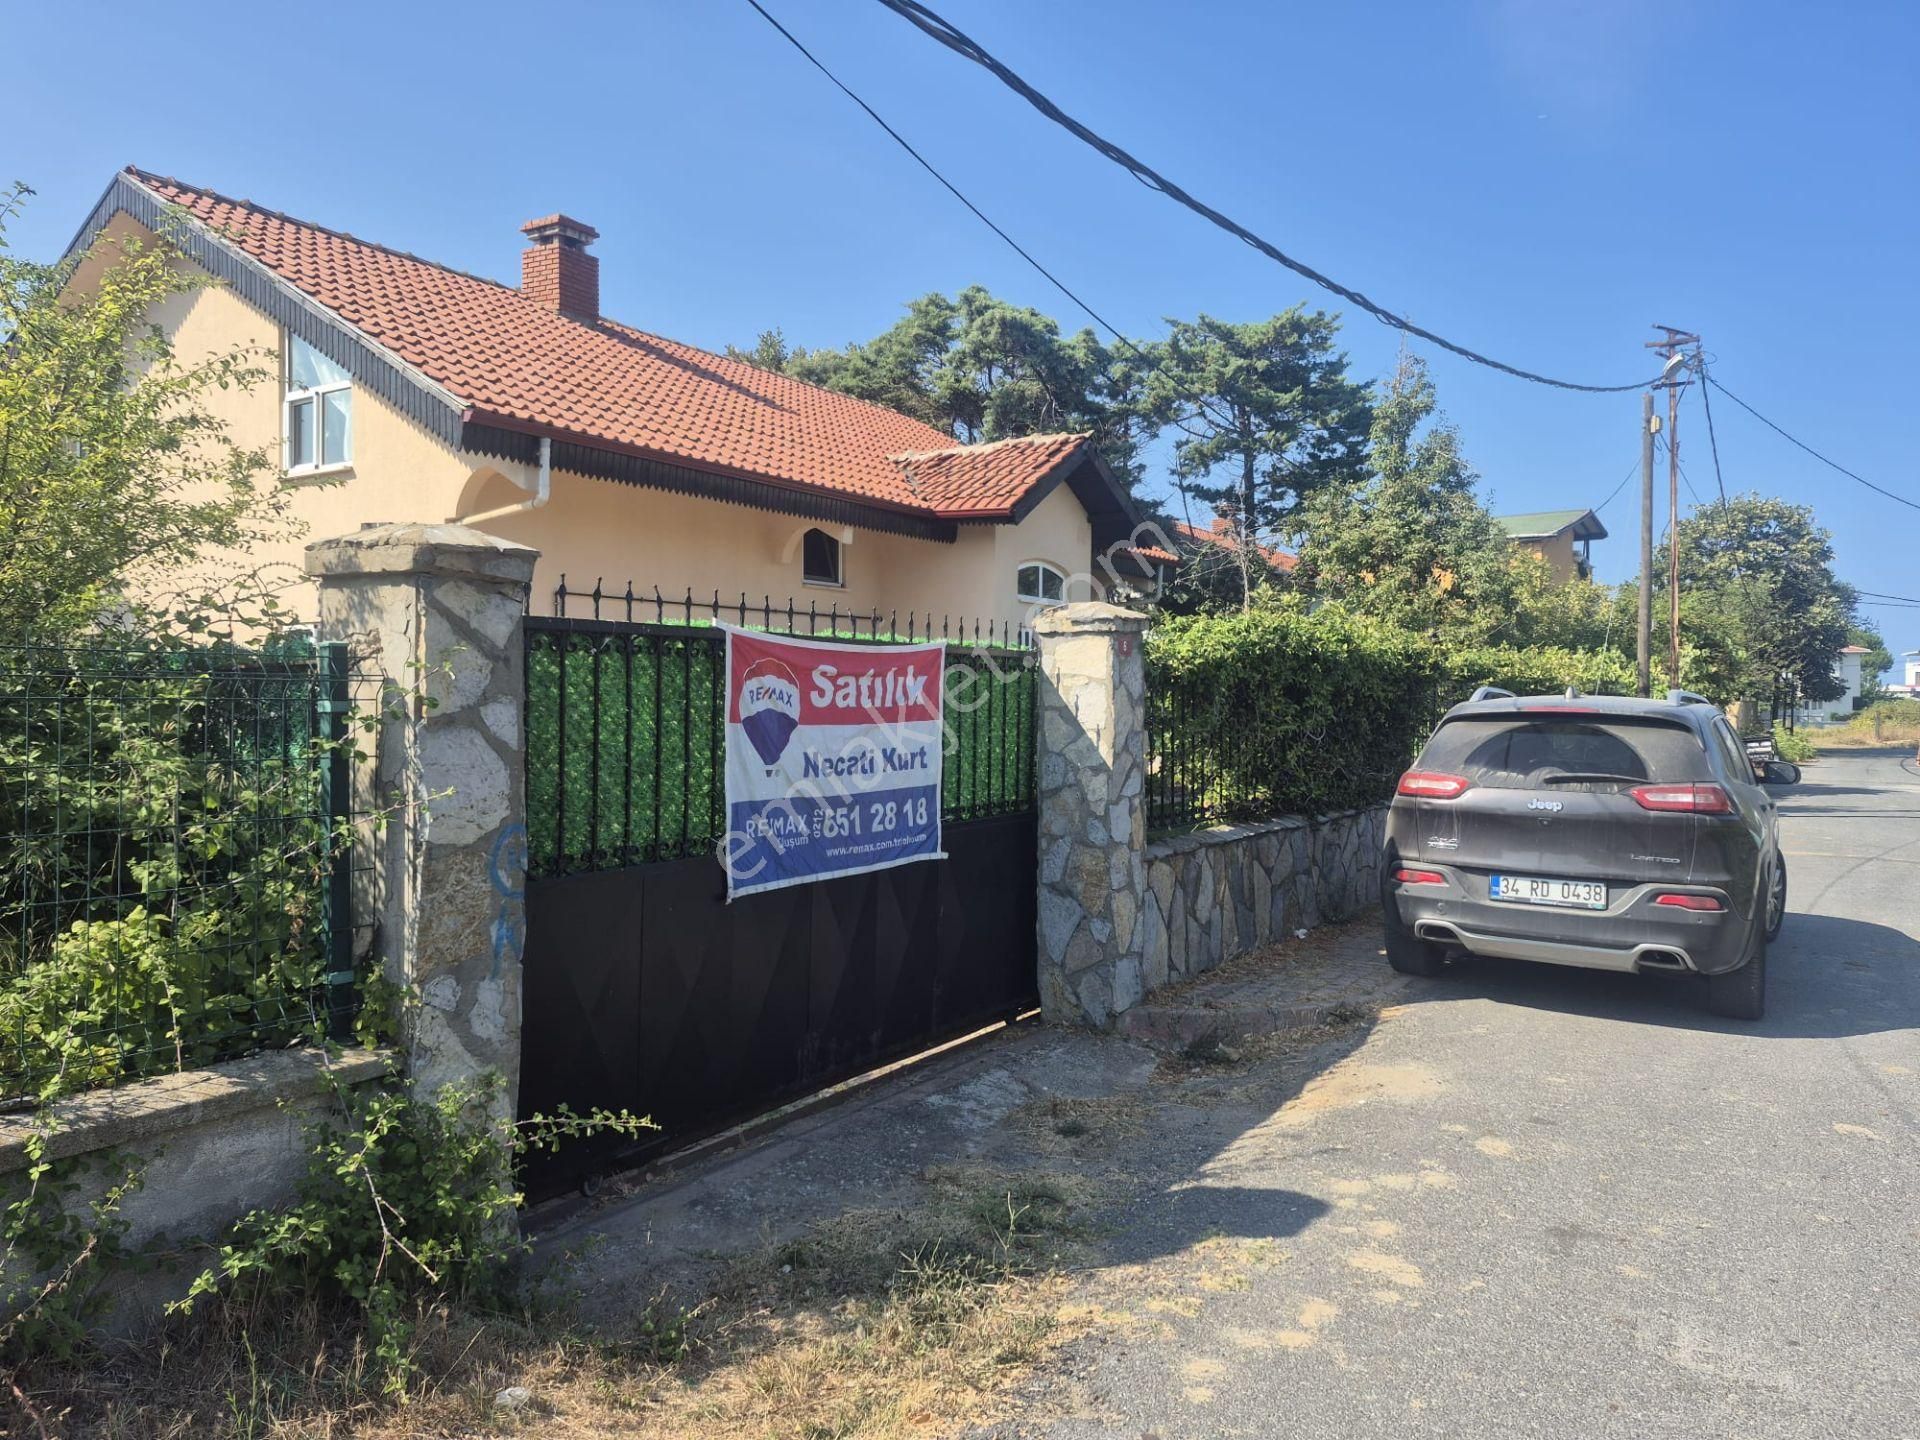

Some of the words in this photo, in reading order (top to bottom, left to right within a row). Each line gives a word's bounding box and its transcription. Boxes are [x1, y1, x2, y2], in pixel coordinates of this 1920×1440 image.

[748, 685, 793, 708] RE/MAX
[810, 664, 928, 709] Satılık
[803, 748, 875, 779] Necati
[881, 746, 928, 774] Kurt
[870, 801, 897, 832] 28
[903, 797, 928, 828] 18
[1527, 798, 1563, 812] Jeep
[812, 808, 824, 838] 0212
[1501, 877, 1519, 895] 34
[1530, 880, 1550, 897] RD
[1561, 882, 1603, 902] 0438
